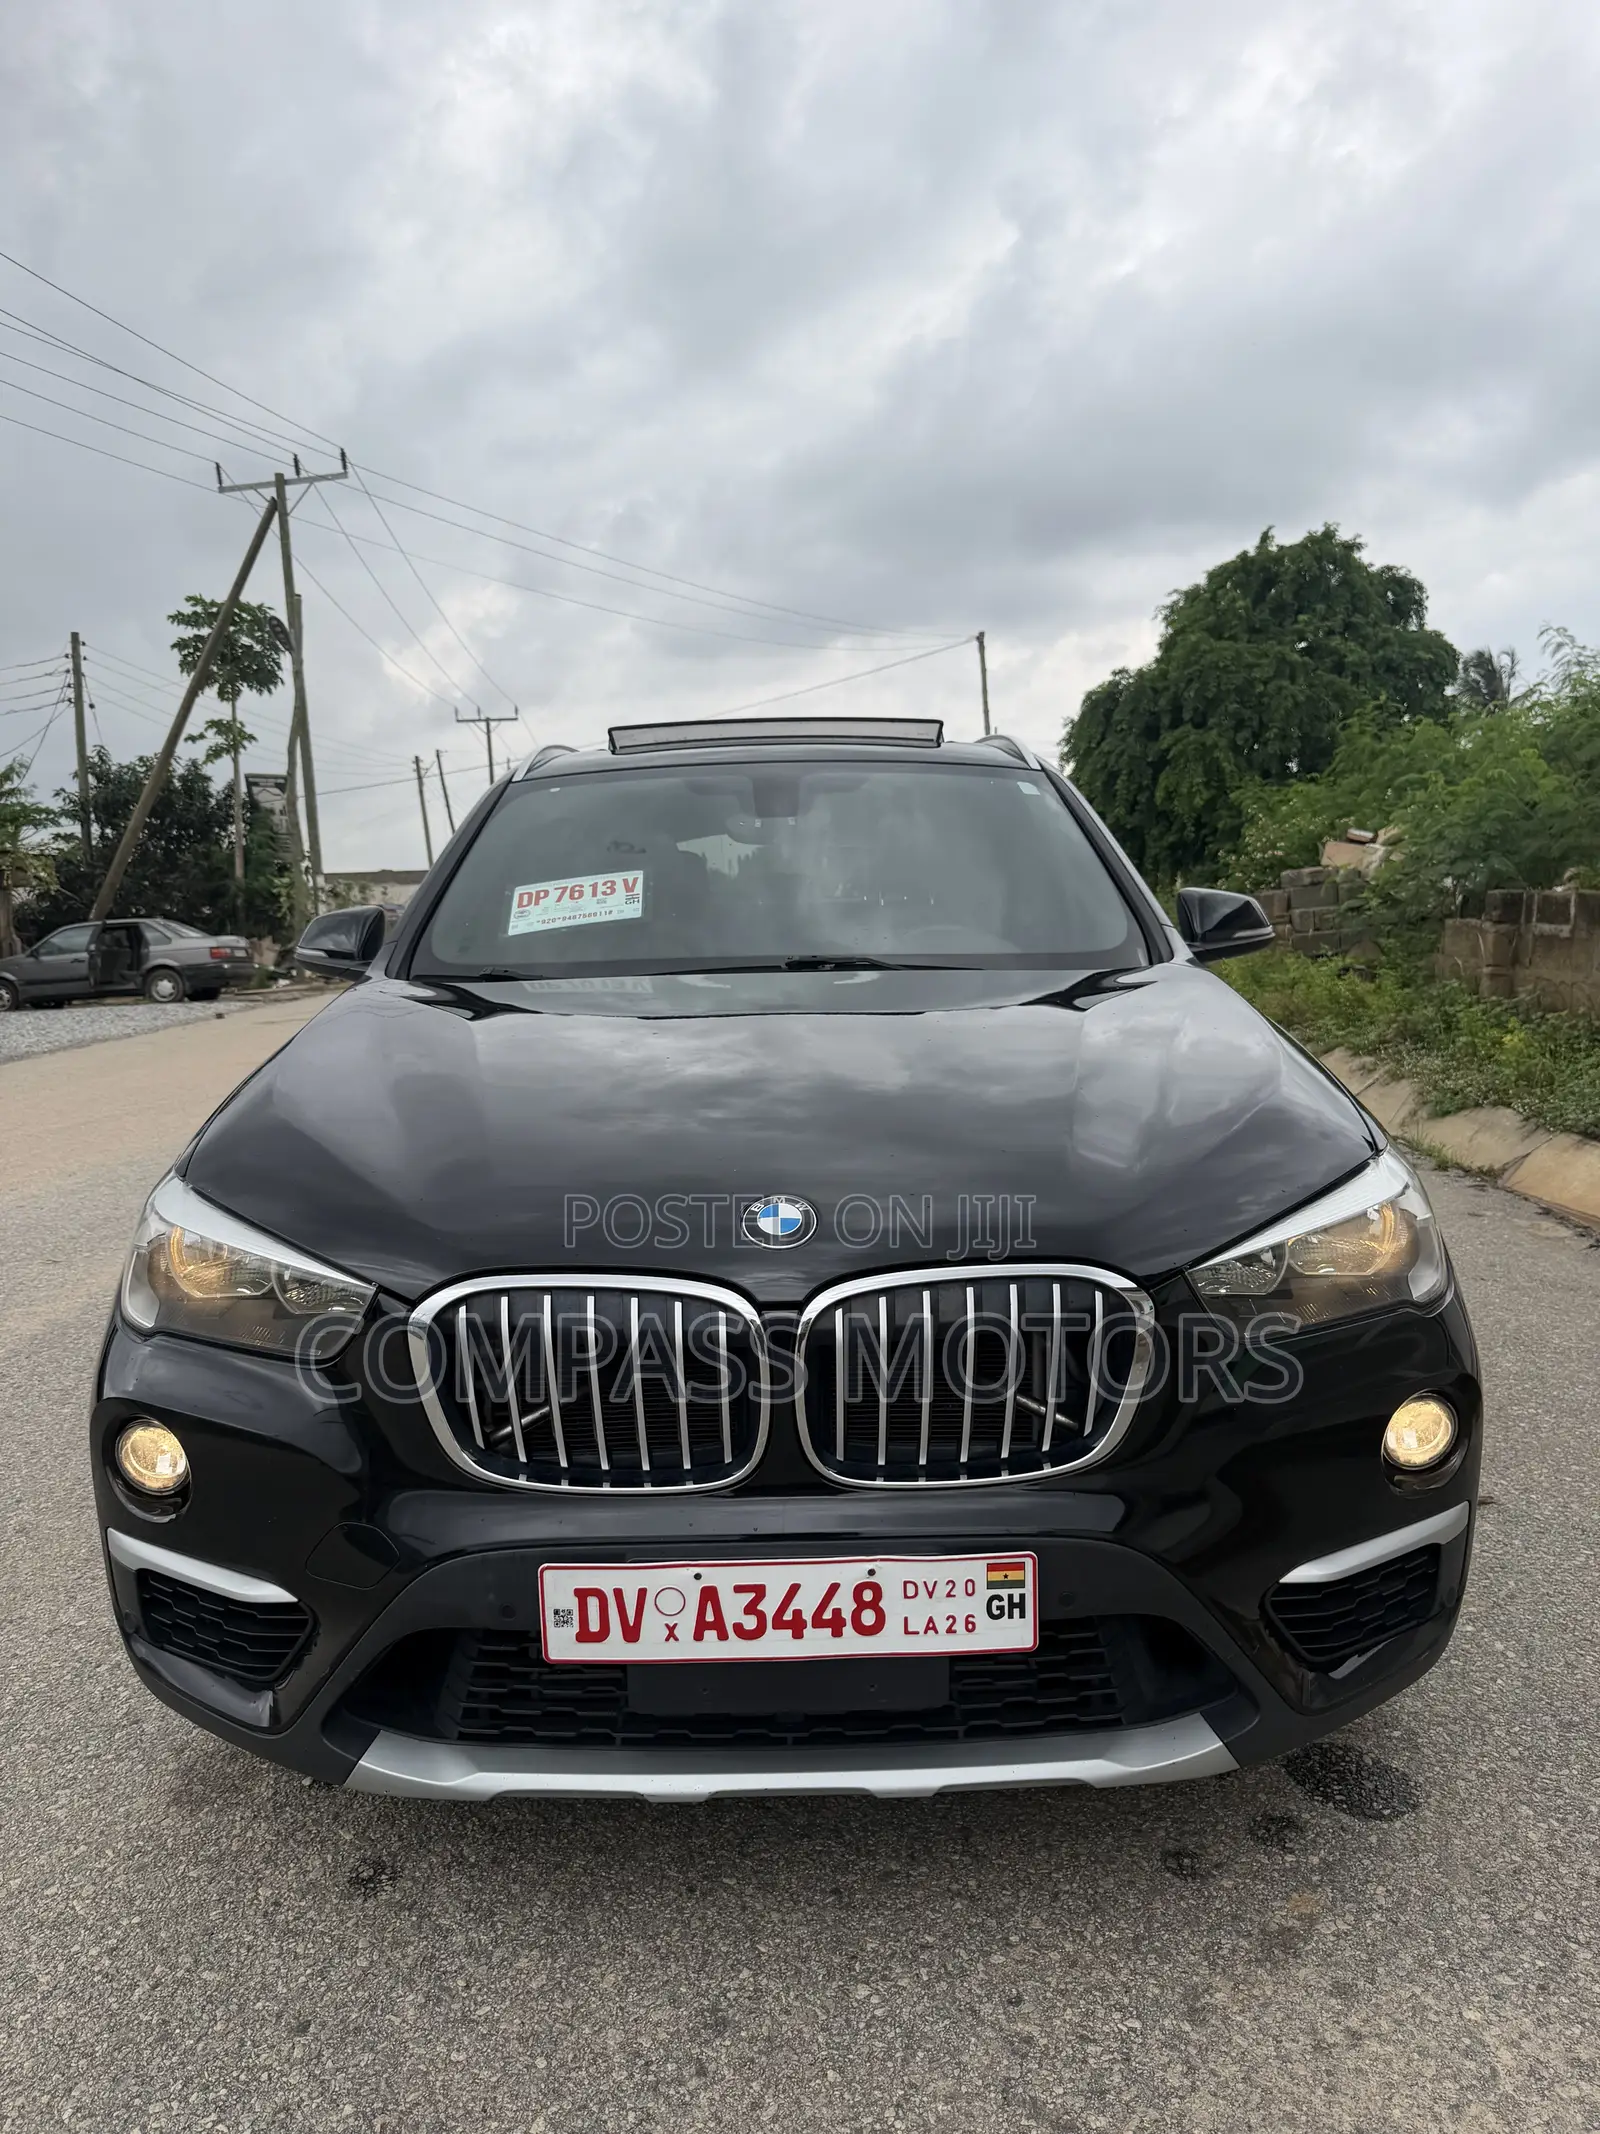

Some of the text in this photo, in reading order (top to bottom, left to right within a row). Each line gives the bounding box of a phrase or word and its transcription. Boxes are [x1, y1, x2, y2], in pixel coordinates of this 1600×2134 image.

[517, 877, 639, 909] DP 7613 V
[573, 1587, 648, 1644] DV
[693, 1580, 886, 1642] A3448
[985, 1592, 1027, 1621] GH
